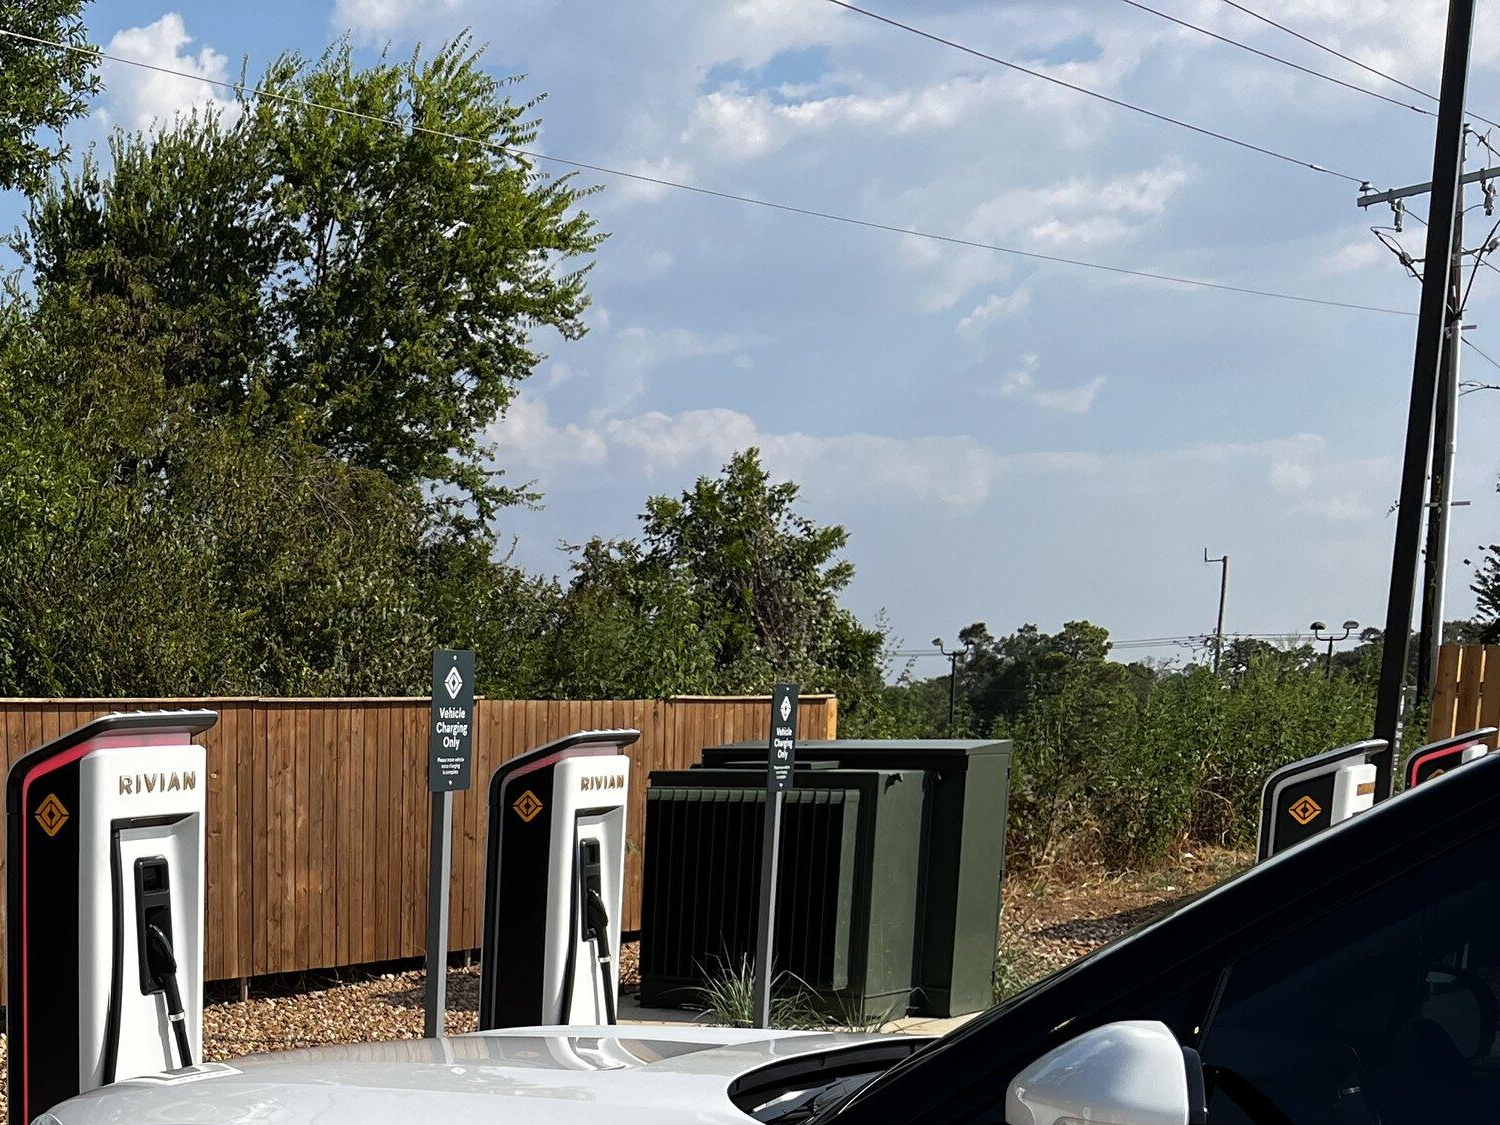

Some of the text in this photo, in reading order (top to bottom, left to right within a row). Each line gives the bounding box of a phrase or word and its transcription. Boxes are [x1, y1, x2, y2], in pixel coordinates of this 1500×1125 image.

[439, 707, 466, 719] Vehicle
[436, 722, 468, 736] Charging
[442, 736, 461, 750] Only
[119, 771, 196, 795] RIVIAN
[580, 775, 623, 791] RIVIAN
